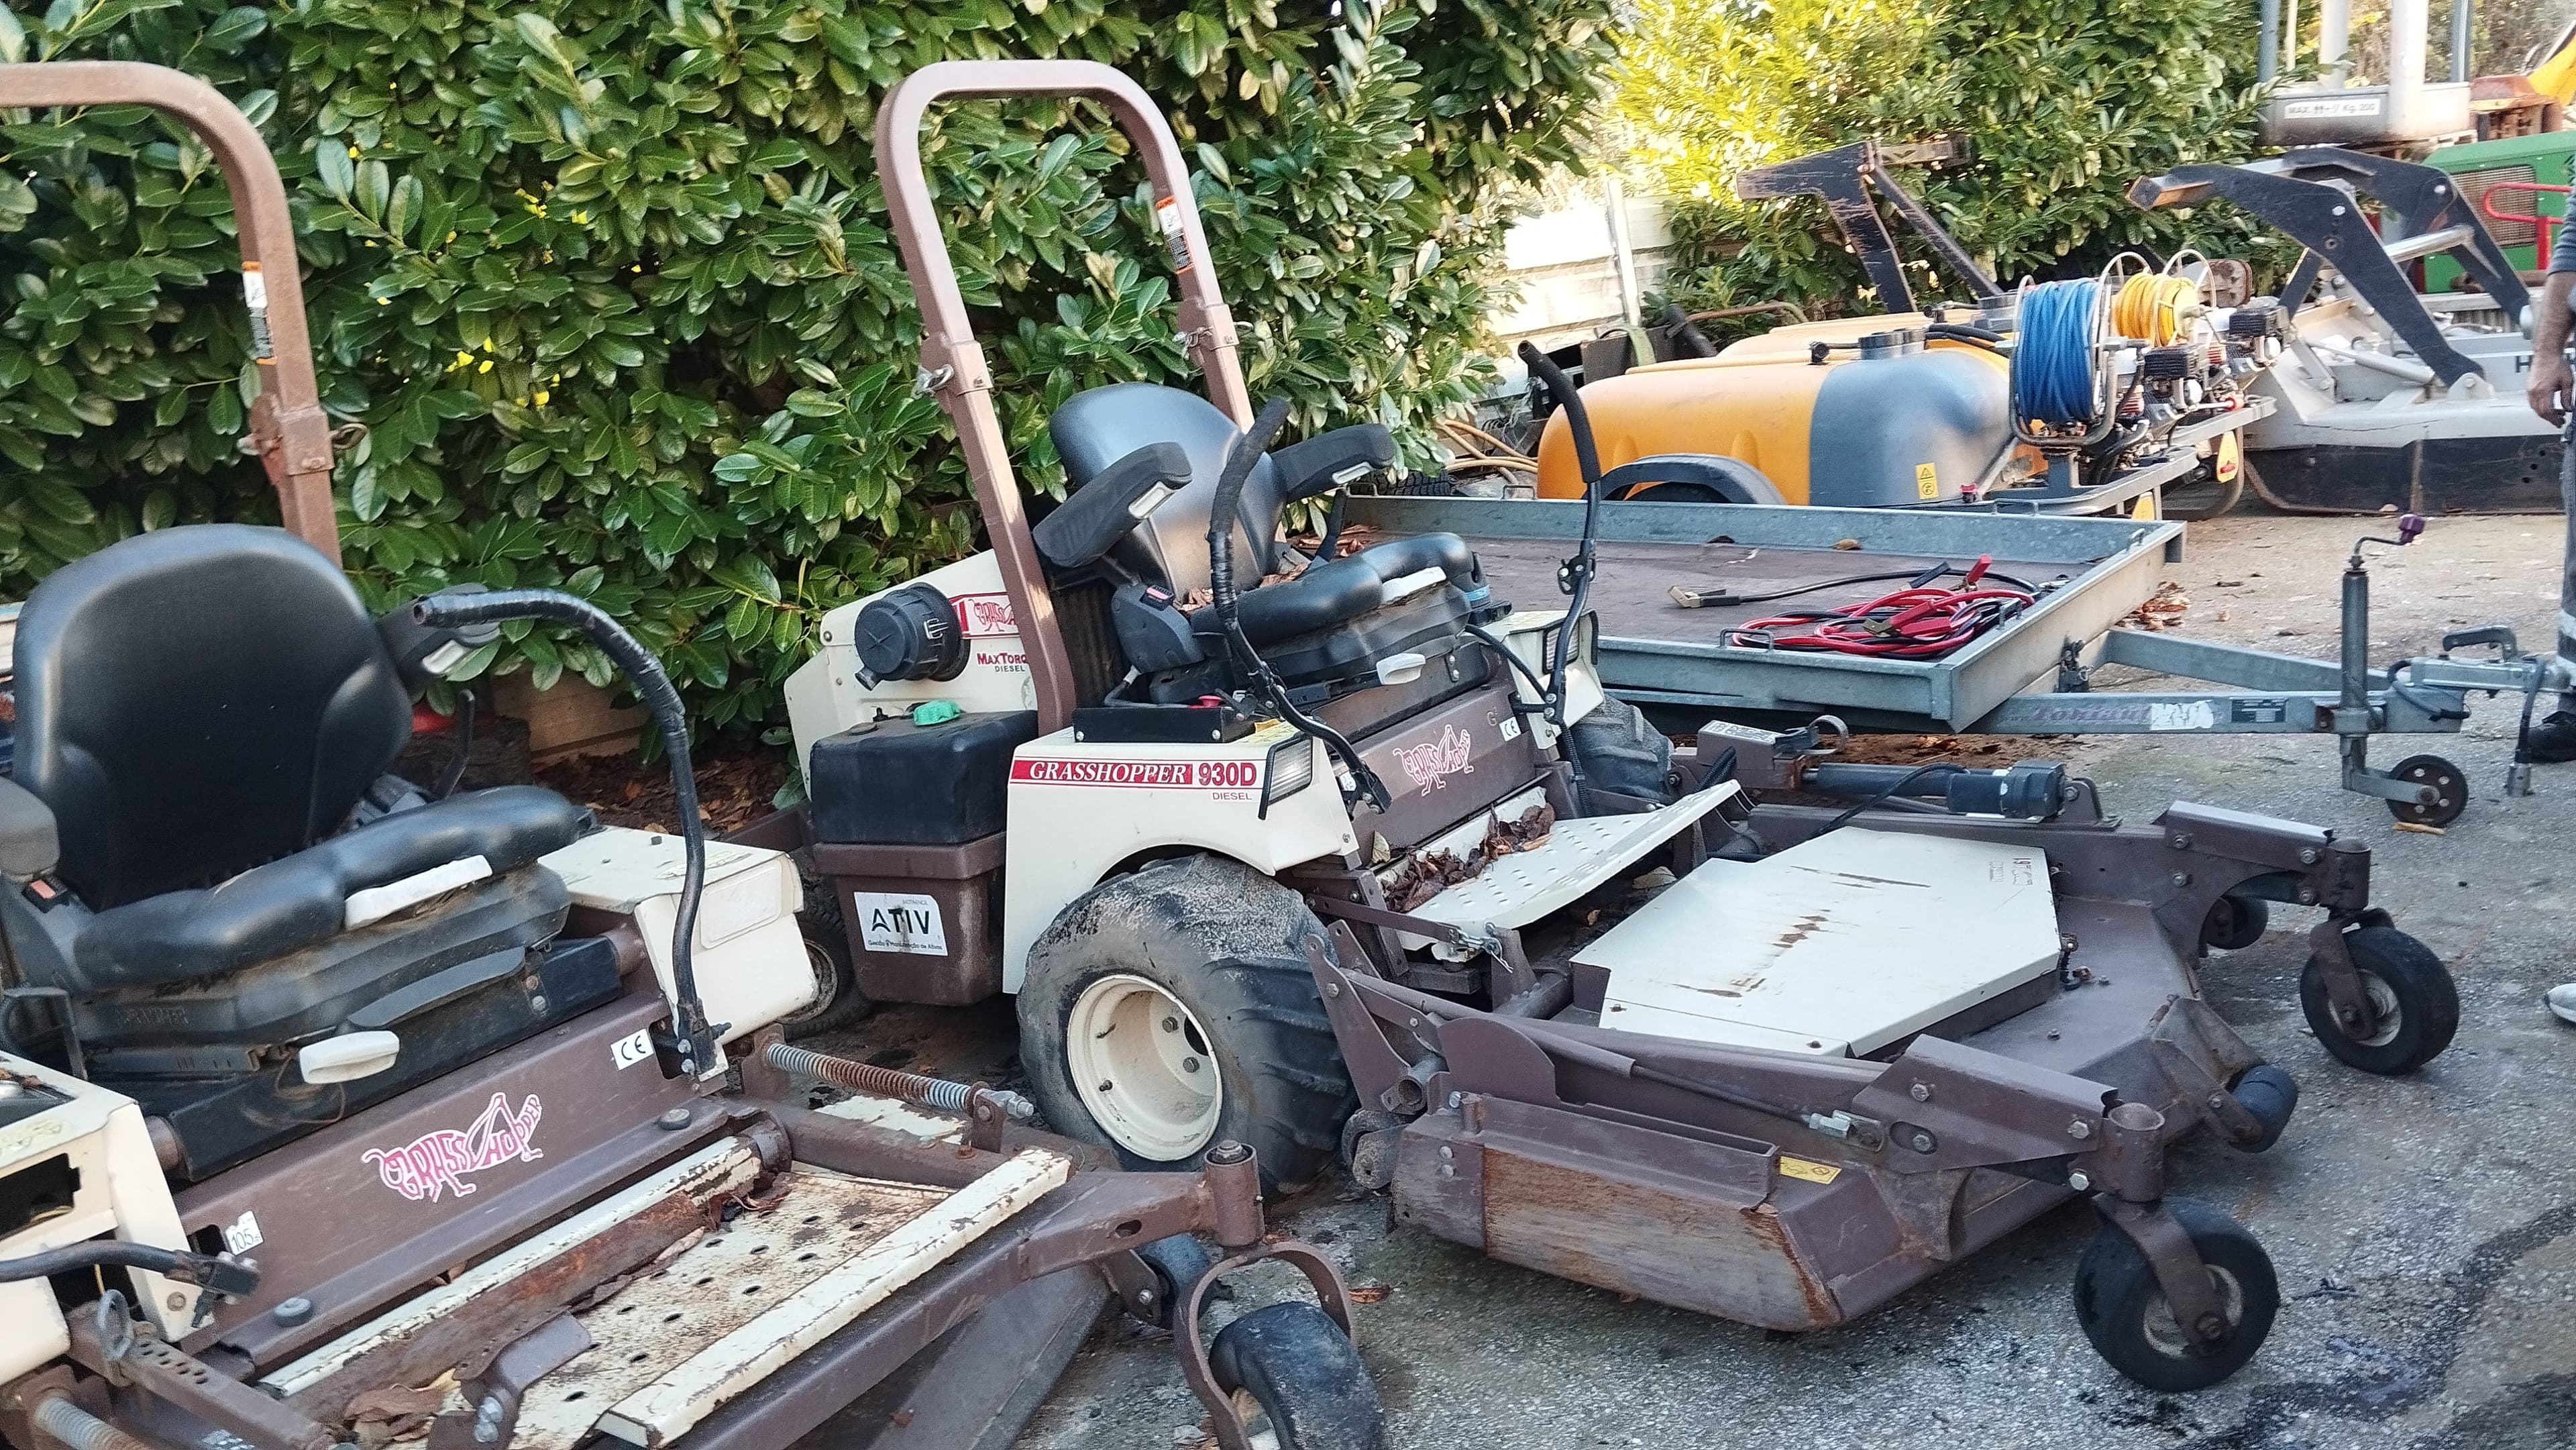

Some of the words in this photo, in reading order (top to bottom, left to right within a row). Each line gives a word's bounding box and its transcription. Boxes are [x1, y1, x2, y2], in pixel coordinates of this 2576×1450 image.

[1029, 762, 1187, 784] GRASSHOPPER
[1198, 762, 1257, 786] 930D
[1212, 792, 1252, 800] DIESEL
[871, 907, 930, 935] ATIV
[231, 1228, 254, 1251] 105
